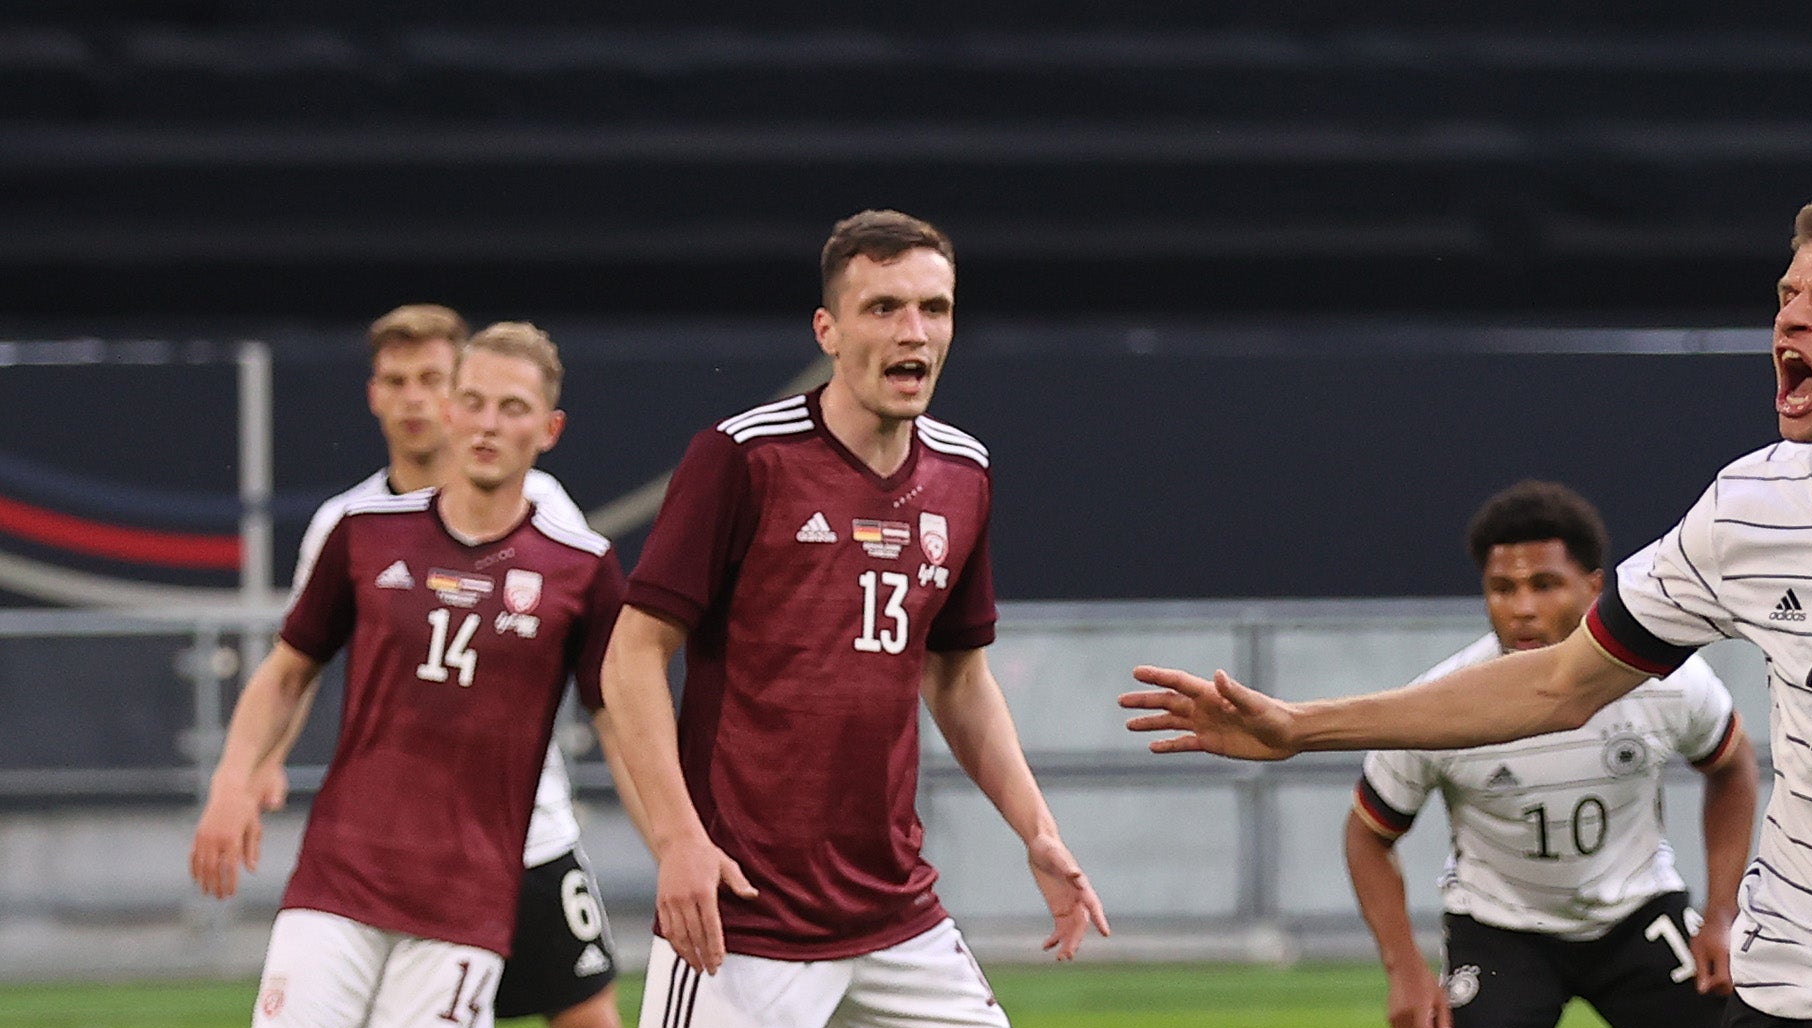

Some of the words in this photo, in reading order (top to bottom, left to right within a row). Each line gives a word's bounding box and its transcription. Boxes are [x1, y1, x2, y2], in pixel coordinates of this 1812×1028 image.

[416, 608, 482, 688] 14
[854, 570, 909, 655] 13
[1769, 611, 1807, 621] adidas
[1524, 796, 1607, 860] 10
[561, 870, 602, 941] 6
